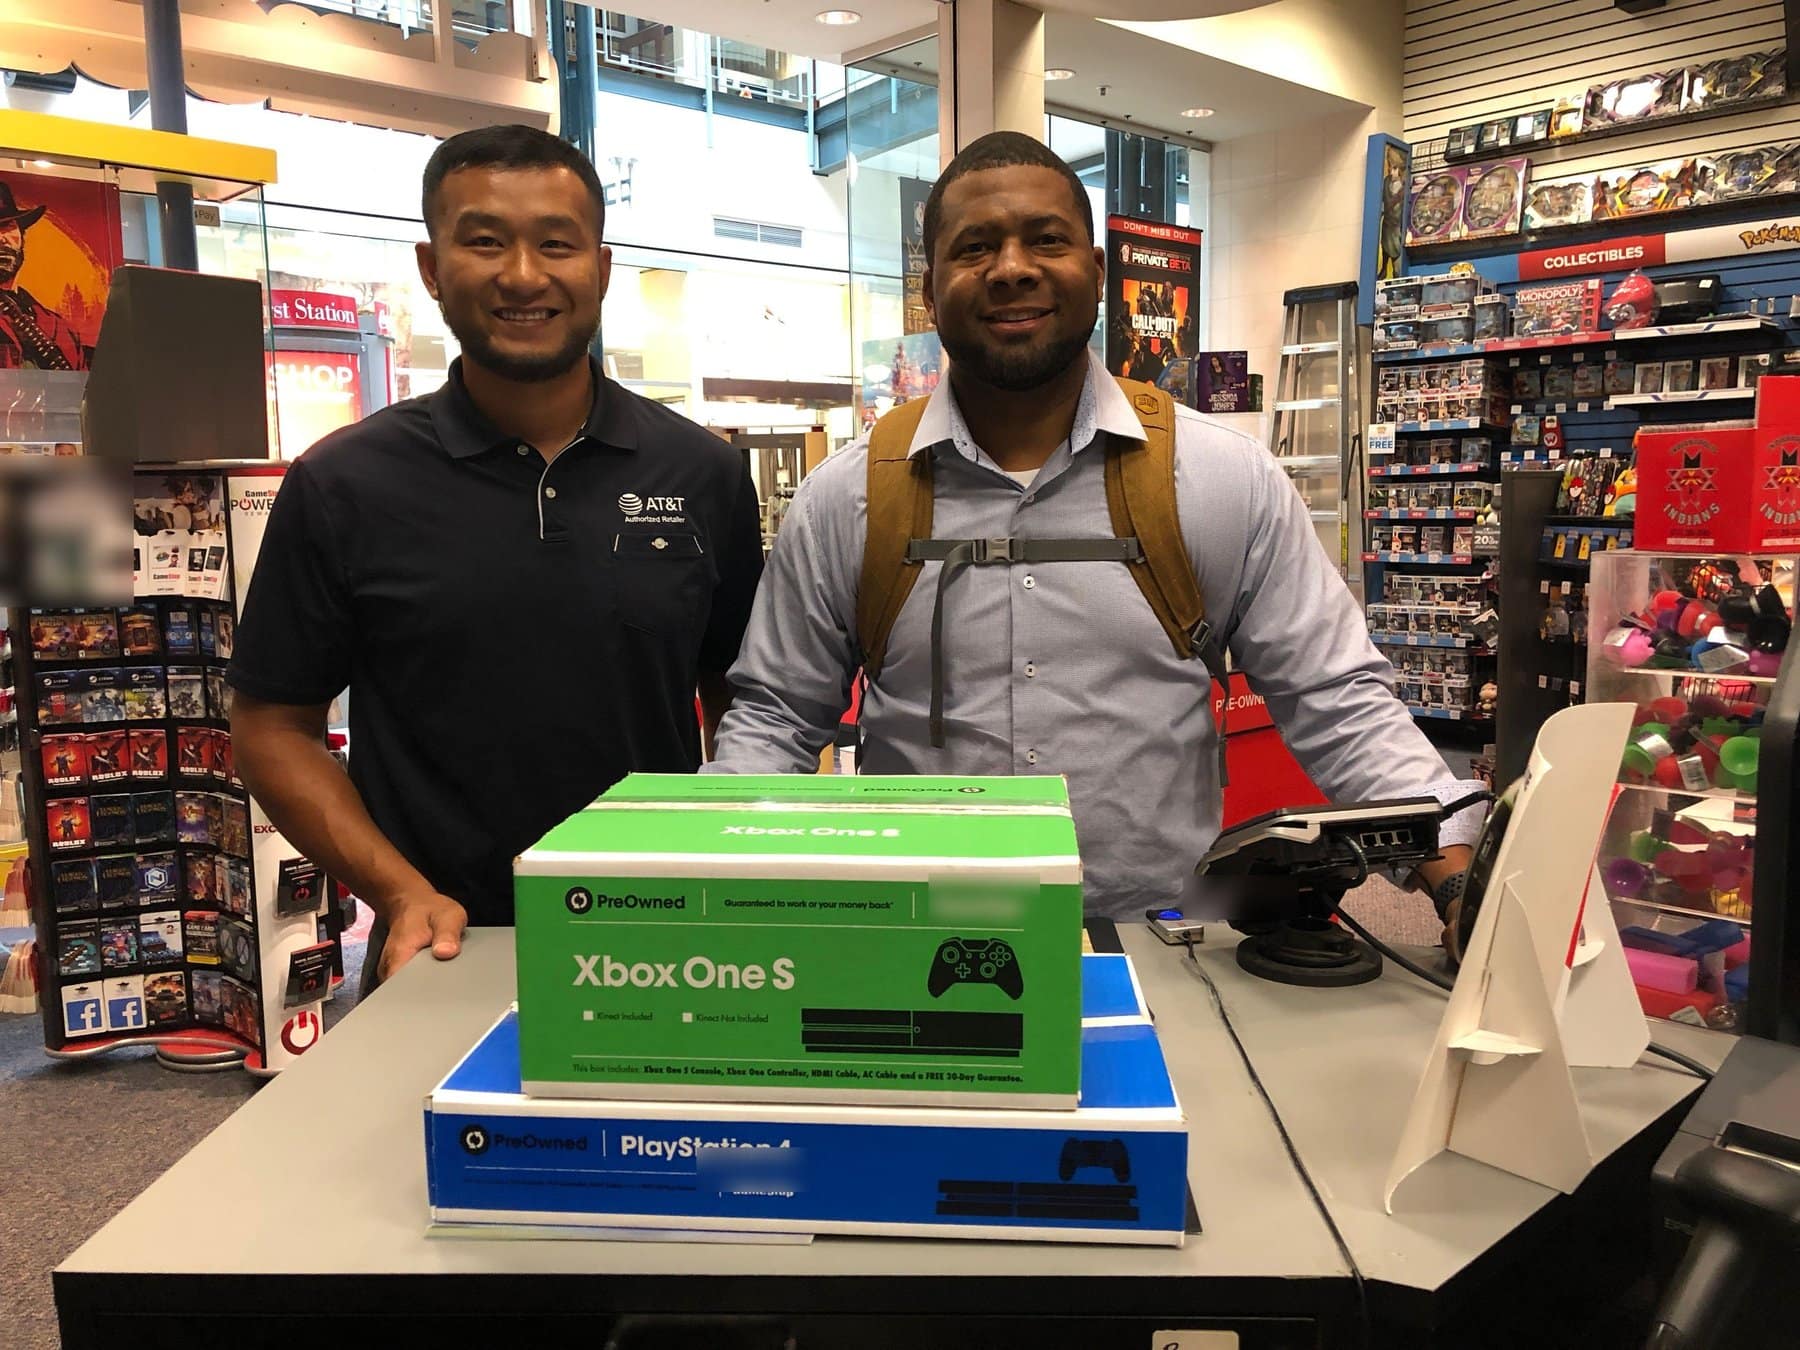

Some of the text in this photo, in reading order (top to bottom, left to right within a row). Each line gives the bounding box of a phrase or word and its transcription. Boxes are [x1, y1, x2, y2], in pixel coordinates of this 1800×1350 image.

[1123, 221, 1190, 240] DON'T MISS OUT
[1132, 252, 1169, 268] PRIVATE
[1169, 258, 1191, 271] BETA
[1543, 245, 1644, 269] COLLECTIBLES
[1520, 287, 1577, 302] MONOPOLY
[272, 302, 291, 319] st
[295, 298, 355, 324] Station
[1132, 314, 1178, 333] CALL DUTY
[268, 363, 353, 388] SHOP
[1369, 441, 1393, 449] FREE
[231, 498, 273, 511] POWE
[646, 497, 685, 511] AT&T
[1663, 503, 1720, 525] INDIANS
[48, 775, 81, 784] ROBLOX
[92, 770, 128, 781] ROBLOX
[254, 825, 277, 833] EXC
[720, 826, 901, 837] Xbox One S
[53, 839, 86, 848] ROBLOX
[597, 894, 686, 909] PreOwned
[724, 899, 775, 908] Guaranteed
[787, 900, 808, 908] work
[819, 901, 838, 910] your
[838, 902, 867, 910] money
[572, 955, 796, 990] Xbox One S
[621, 1012, 653, 1021] Included
[737, 1014, 769, 1023] Included
[573, 1064, 588, 1072] This
[590, 1064, 605, 1072] box
[644, 1065, 663, 1074] Xbox
[666, 1066, 682, 1074] One
[683, 1066, 688, 1074] S
[727, 1067, 747, 1075] Xbox
[749, 1068, 765, 1076] One
[875, 1071, 898, 1079] Cable
[900, 1072, 916, 1080] and
[925, 1072, 944, 1080] FREE
[494, 1134, 588, 1150] PreOwned
